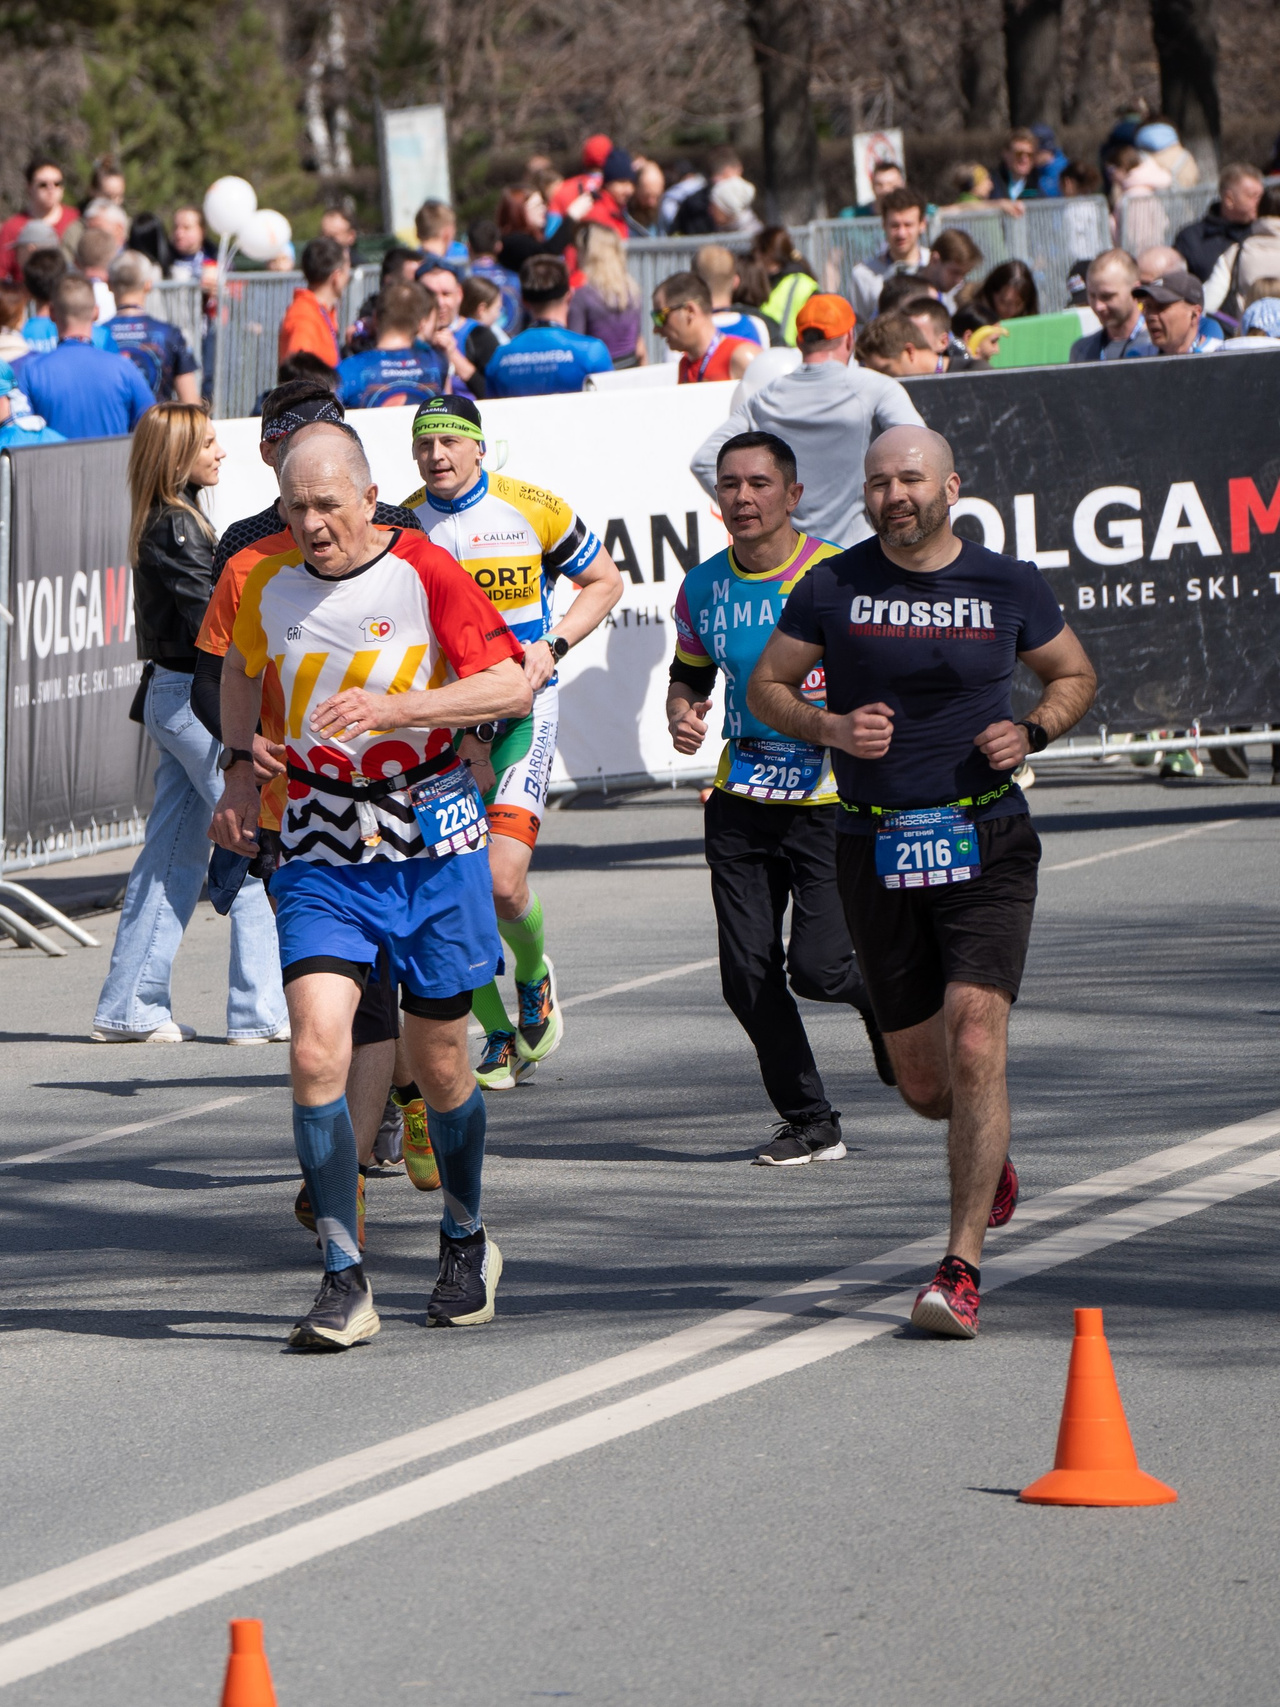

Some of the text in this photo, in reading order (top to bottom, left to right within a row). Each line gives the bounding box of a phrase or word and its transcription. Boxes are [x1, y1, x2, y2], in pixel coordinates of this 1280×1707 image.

[421, 406, 448, 414] GARMIN
[519, 492, 560, 516] VLAANDEREN
[520, 485, 559, 507] SPORT
[950, 477, 1280, 569] OLGAM
[483, 532, 526, 542] CALLANT
[603, 511, 701, 584] AN
[467, 566, 532, 588] ORT
[483, 585, 534, 601] NDEREN
[1078, 575, 1240, 609] BIKE SKI
[17, 565, 135, 661] VOLGAMA
[700, 599, 786, 635] SAMA
[850, 595, 995, 628] CrossFit
[849, 623, 997, 640] FORGING ELITE FITNESS
[67, 671, 87, 699] BIKE
[92, 668, 107, 693] SKI
[761, 745, 796, 753] КОСМОС
[524, 721, 549, 803] BARDIANI
[748, 763, 802, 789] 2216
[435, 794, 478, 837] 2230
[900, 818, 942, 826] КОСМОС
[905, 812, 941, 820] ПРОСТО
[904, 829, 934, 838] ЕВГЕНИЙ
[896, 839, 952, 870] 2116
[959, 842, 969, 851] C
